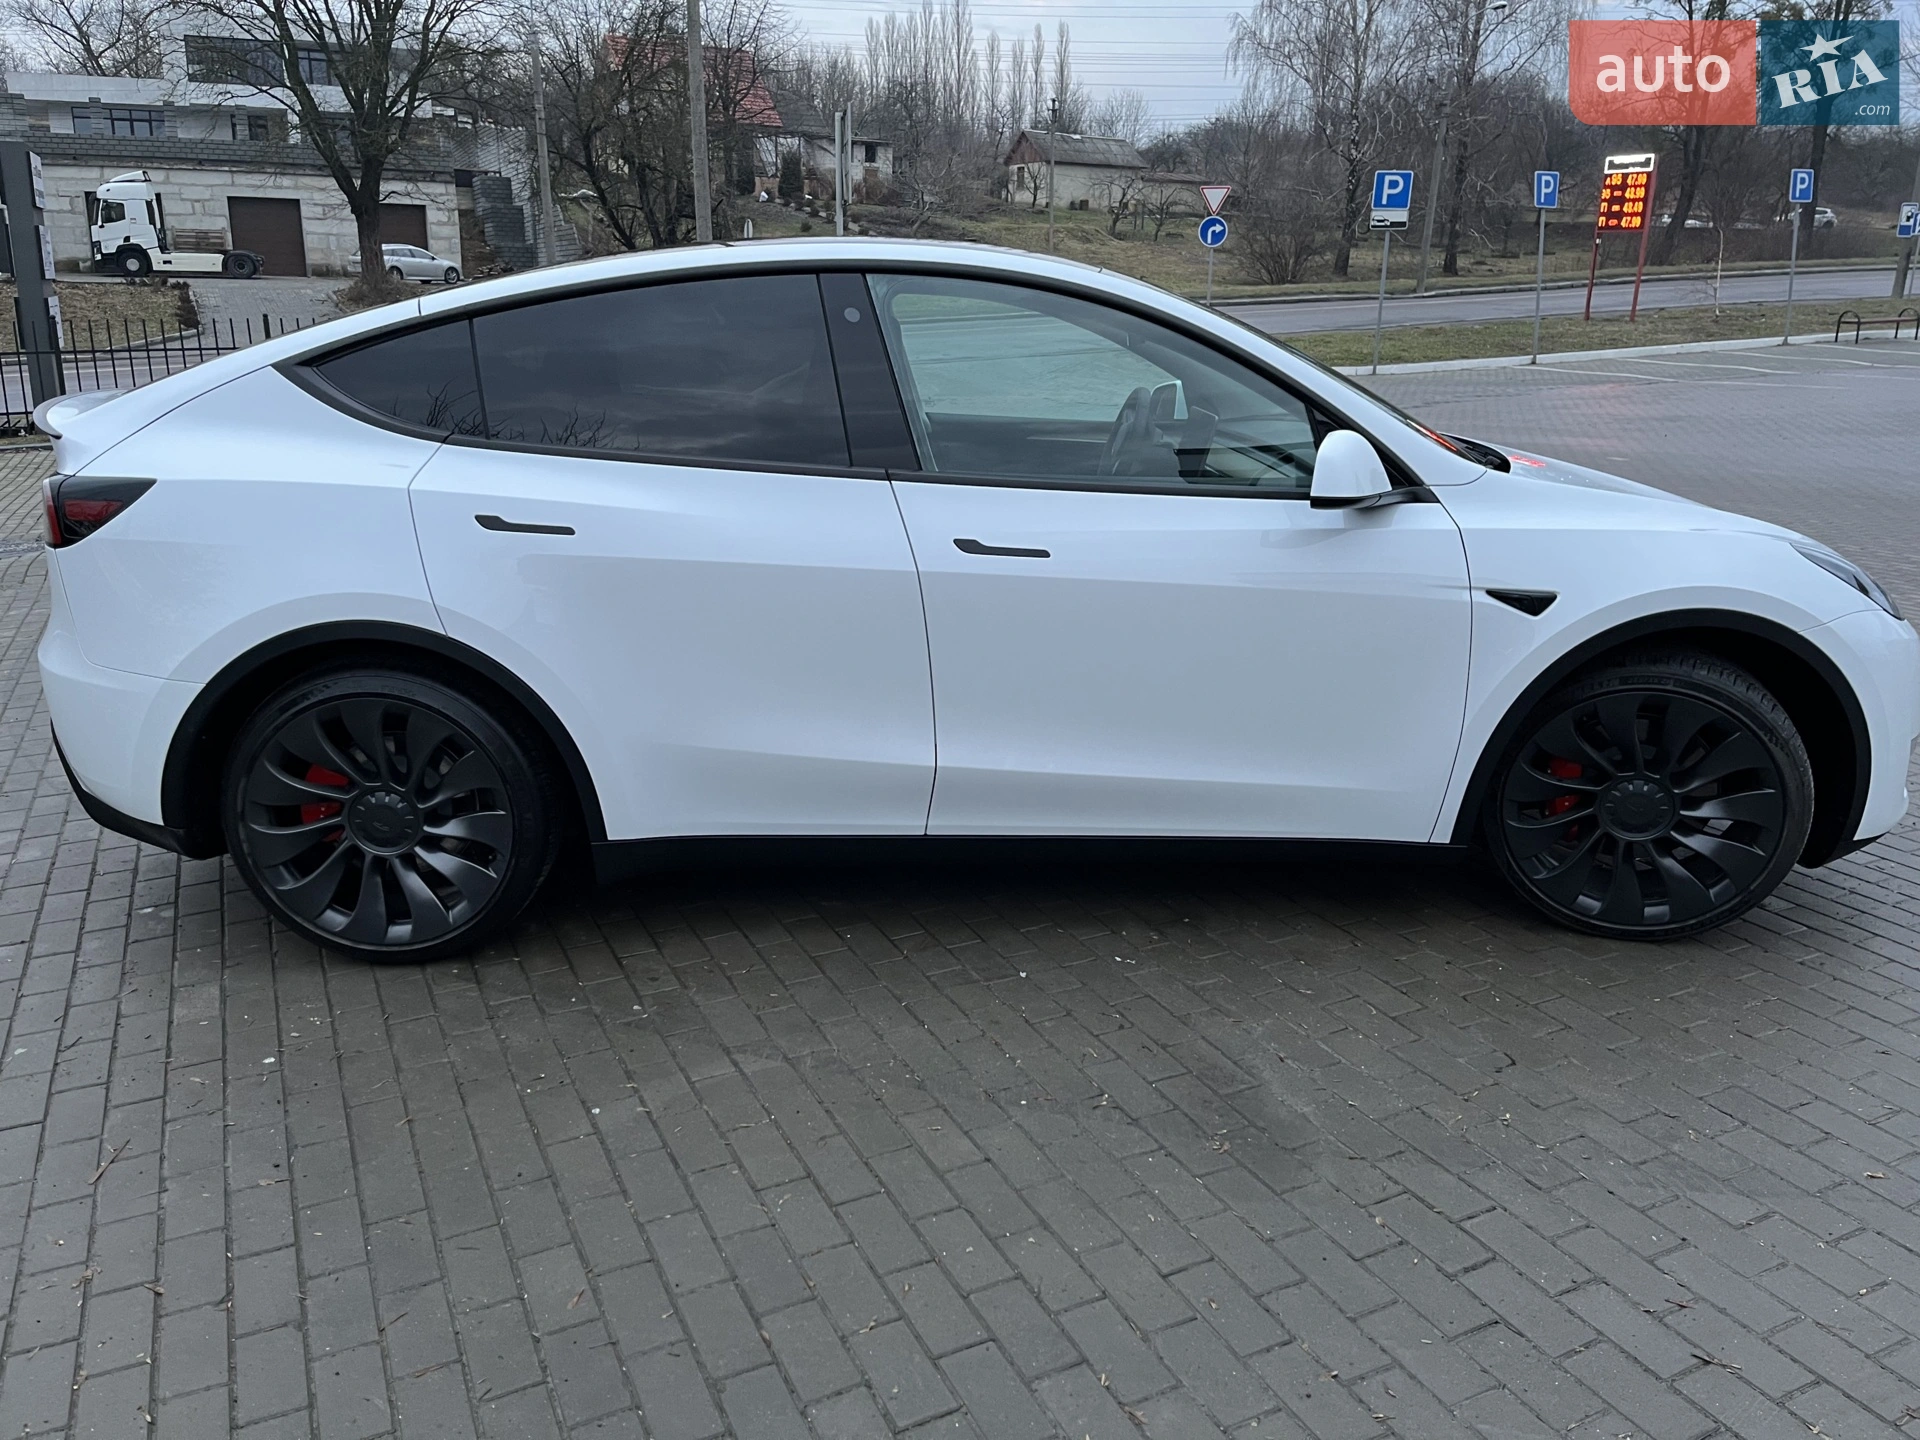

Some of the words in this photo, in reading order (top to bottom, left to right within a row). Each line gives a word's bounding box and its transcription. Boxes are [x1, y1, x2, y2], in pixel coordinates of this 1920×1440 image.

[1382, 175, 1404, 205] P
[1541, 175, 1554, 203] P
[1796, 173, 1809, 198] P
